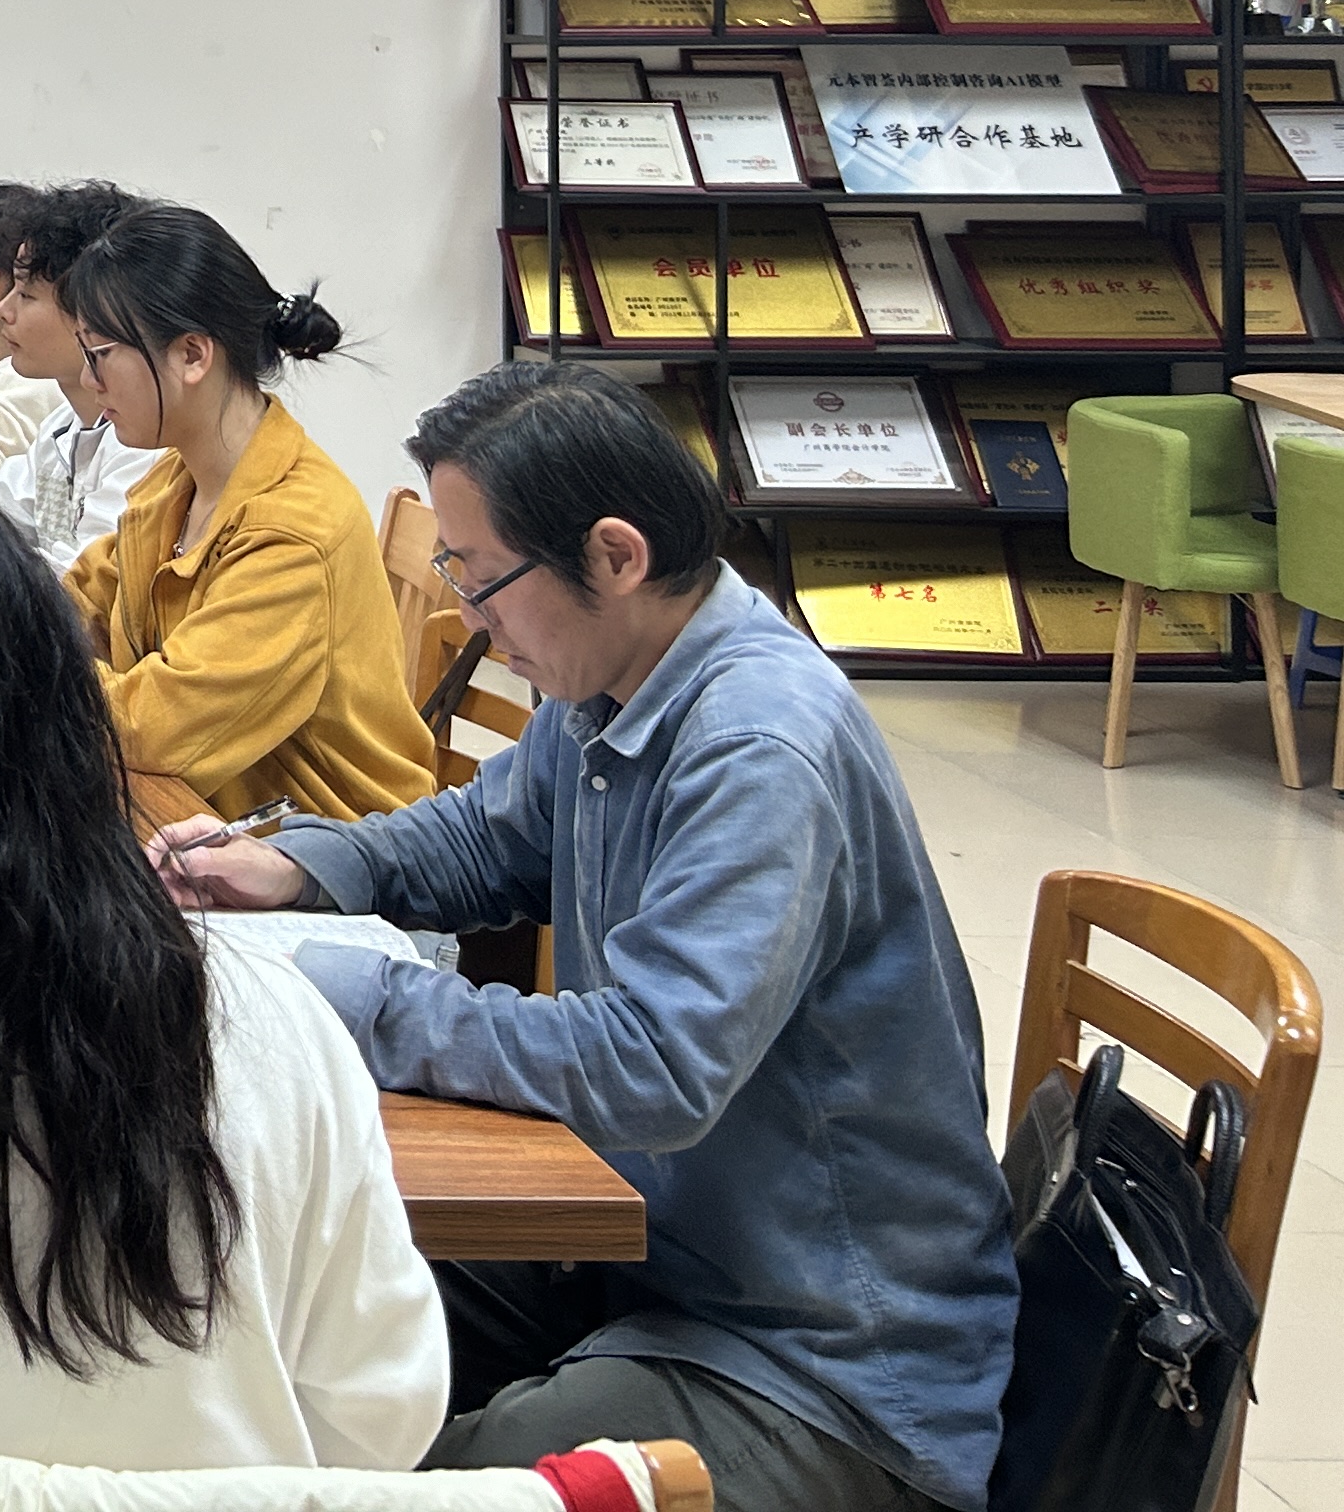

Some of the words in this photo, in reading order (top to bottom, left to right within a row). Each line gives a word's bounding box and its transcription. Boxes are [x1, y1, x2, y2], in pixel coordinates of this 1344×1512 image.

[850, 123, 1083, 150] 产学研合作基地
[652, 258, 781, 279] 会员单位
[1018, 278, 1161, 296] 优秀组织奖
[785, 421, 901, 439] 副会长单位
[869, 582, 939, 604] 第七名
